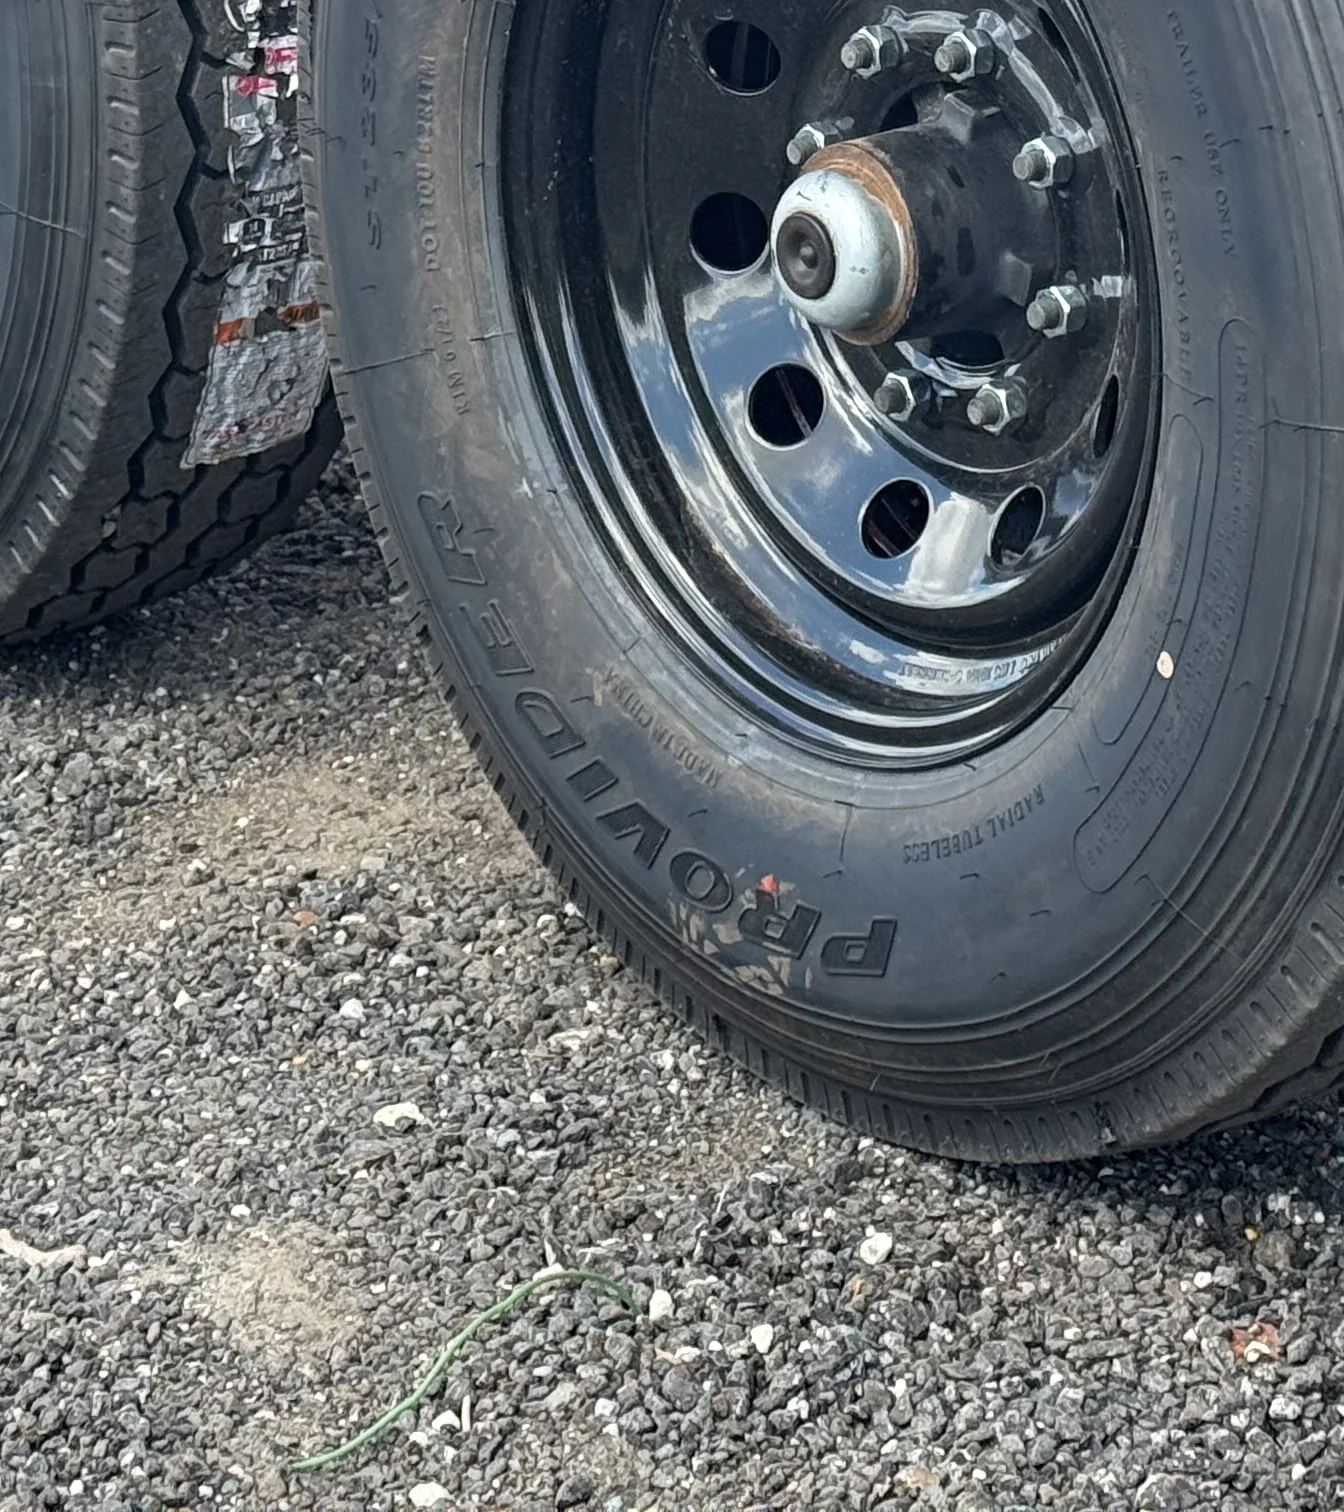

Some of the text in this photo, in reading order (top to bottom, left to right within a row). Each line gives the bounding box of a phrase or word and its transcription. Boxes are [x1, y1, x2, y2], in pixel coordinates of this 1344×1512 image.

[416, 491, 898, 978] PROVIDER
[902, 783, 1046, 864] RADIAL TUBELESS
